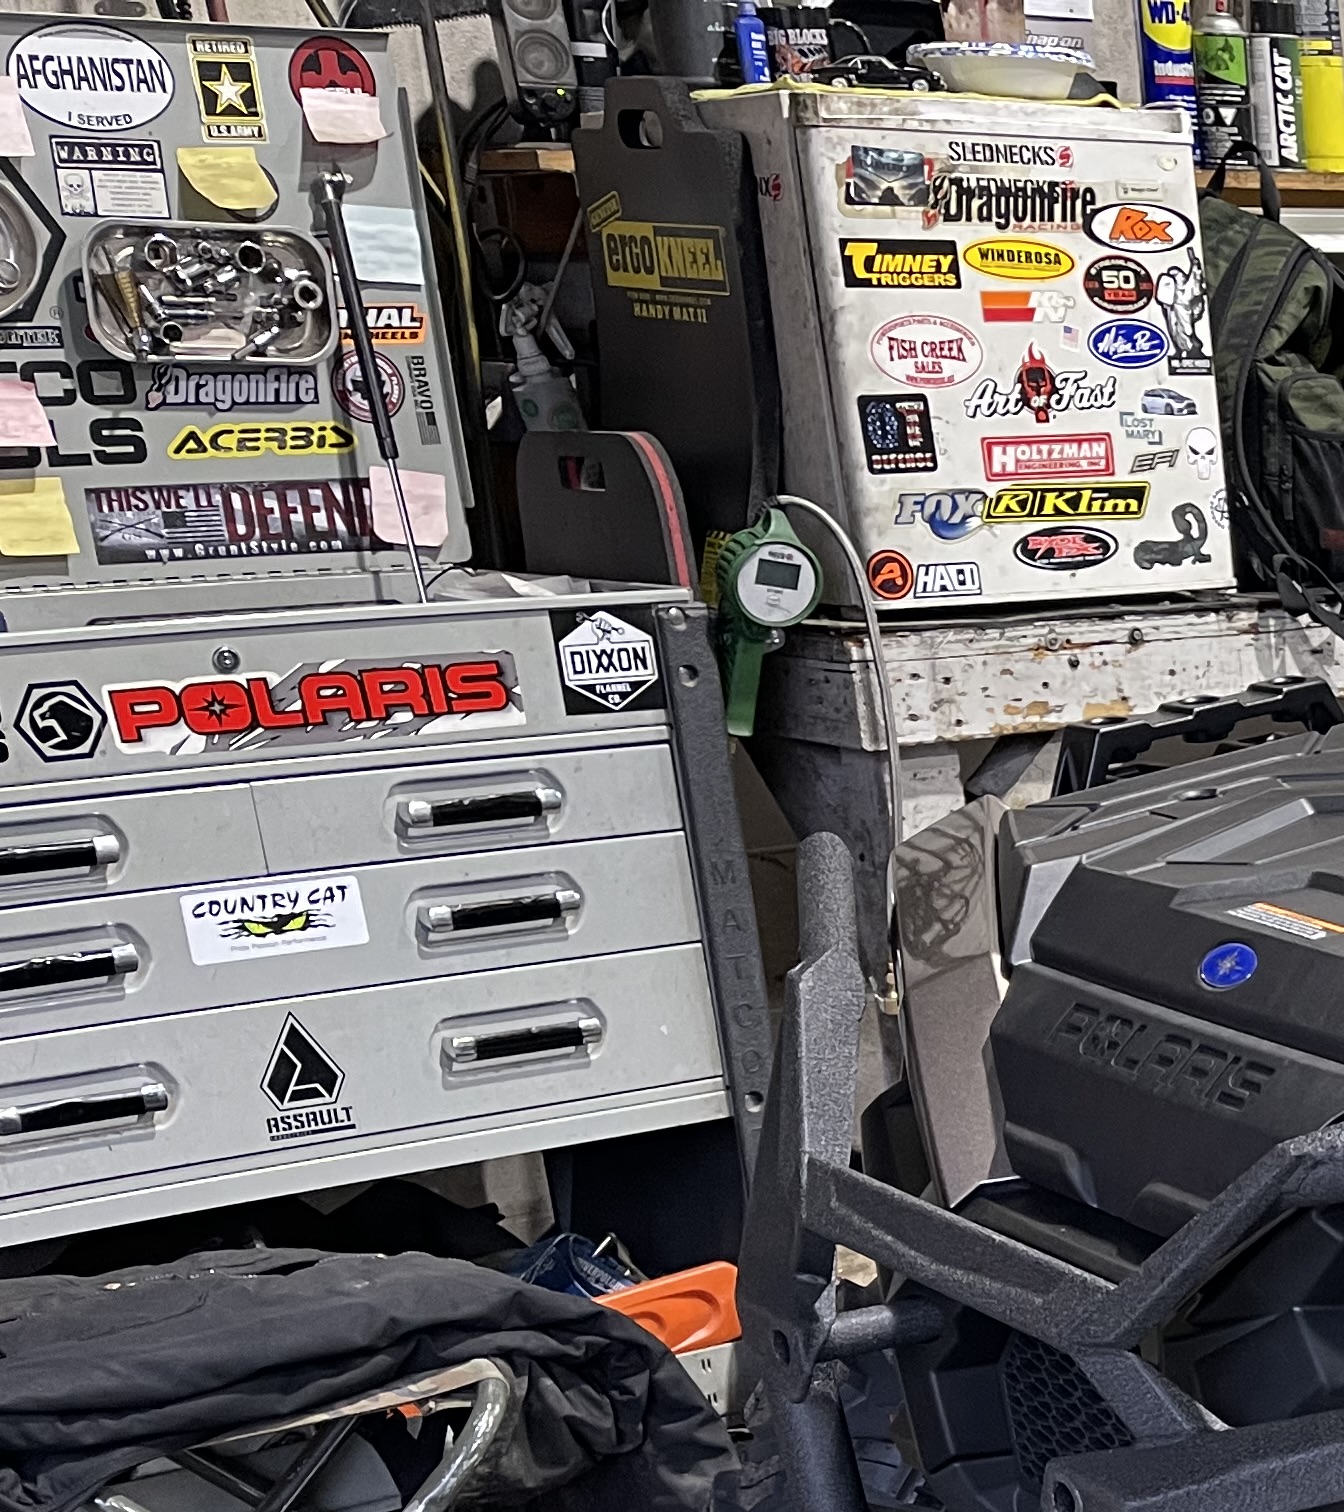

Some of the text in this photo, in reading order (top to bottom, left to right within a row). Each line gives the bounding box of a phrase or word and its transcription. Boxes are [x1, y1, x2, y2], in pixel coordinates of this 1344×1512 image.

[195, 40, 245, 53] RETIRED
[767, 30, 786, 45] BIG
[15, 53, 168, 94] AFGHANISTAN
[1274, 48, 1294, 90] CAT
[68, 111, 133, 127] I SERVED
[1277, 91, 1298, 163] ARCTIC
[57, 145, 154, 161] WARNING
[949, 141, 1056, 166] SLEDNECKS
[656, 236, 724, 280] KNEEL
[845, 242, 954, 279] TIMNEY
[978, 247, 1063, 266] WINDEROSA
[871, 273, 957, 287] TRIGGERS
[1102, 270, 1135, 289] 50
[633, 302, 670, 319] HANDY
[371, 331, 420, 340] HEELS
[887, 336, 968, 363] FISH CREEK
[914, 361, 943, 374] SALES
[171, 366, 317, 409] DragonFire
[411, 355, 434, 410] BRAVO
[964, 378, 1023, 418] Art
[1050, 370, 1117, 412] Fast
[1124, 418, 1154, 429] LOST
[1125, 430, 1157, 440] MARY
[991, 442, 1106, 473] HOLTZMAN
[1129, 449, 1181, 474] EFI
[100, 488, 148, 514] THIS
[894, 491, 986, 526] FOX
[570, 646, 648, 675] DIXXON
[107, 660, 513, 745] POLARIS
[192, 885, 348, 918] COUNTRY CAT
[1045, 1002, 1276, 1113] POLARIS
[266, 1106, 352, 1133] ASSAULT
